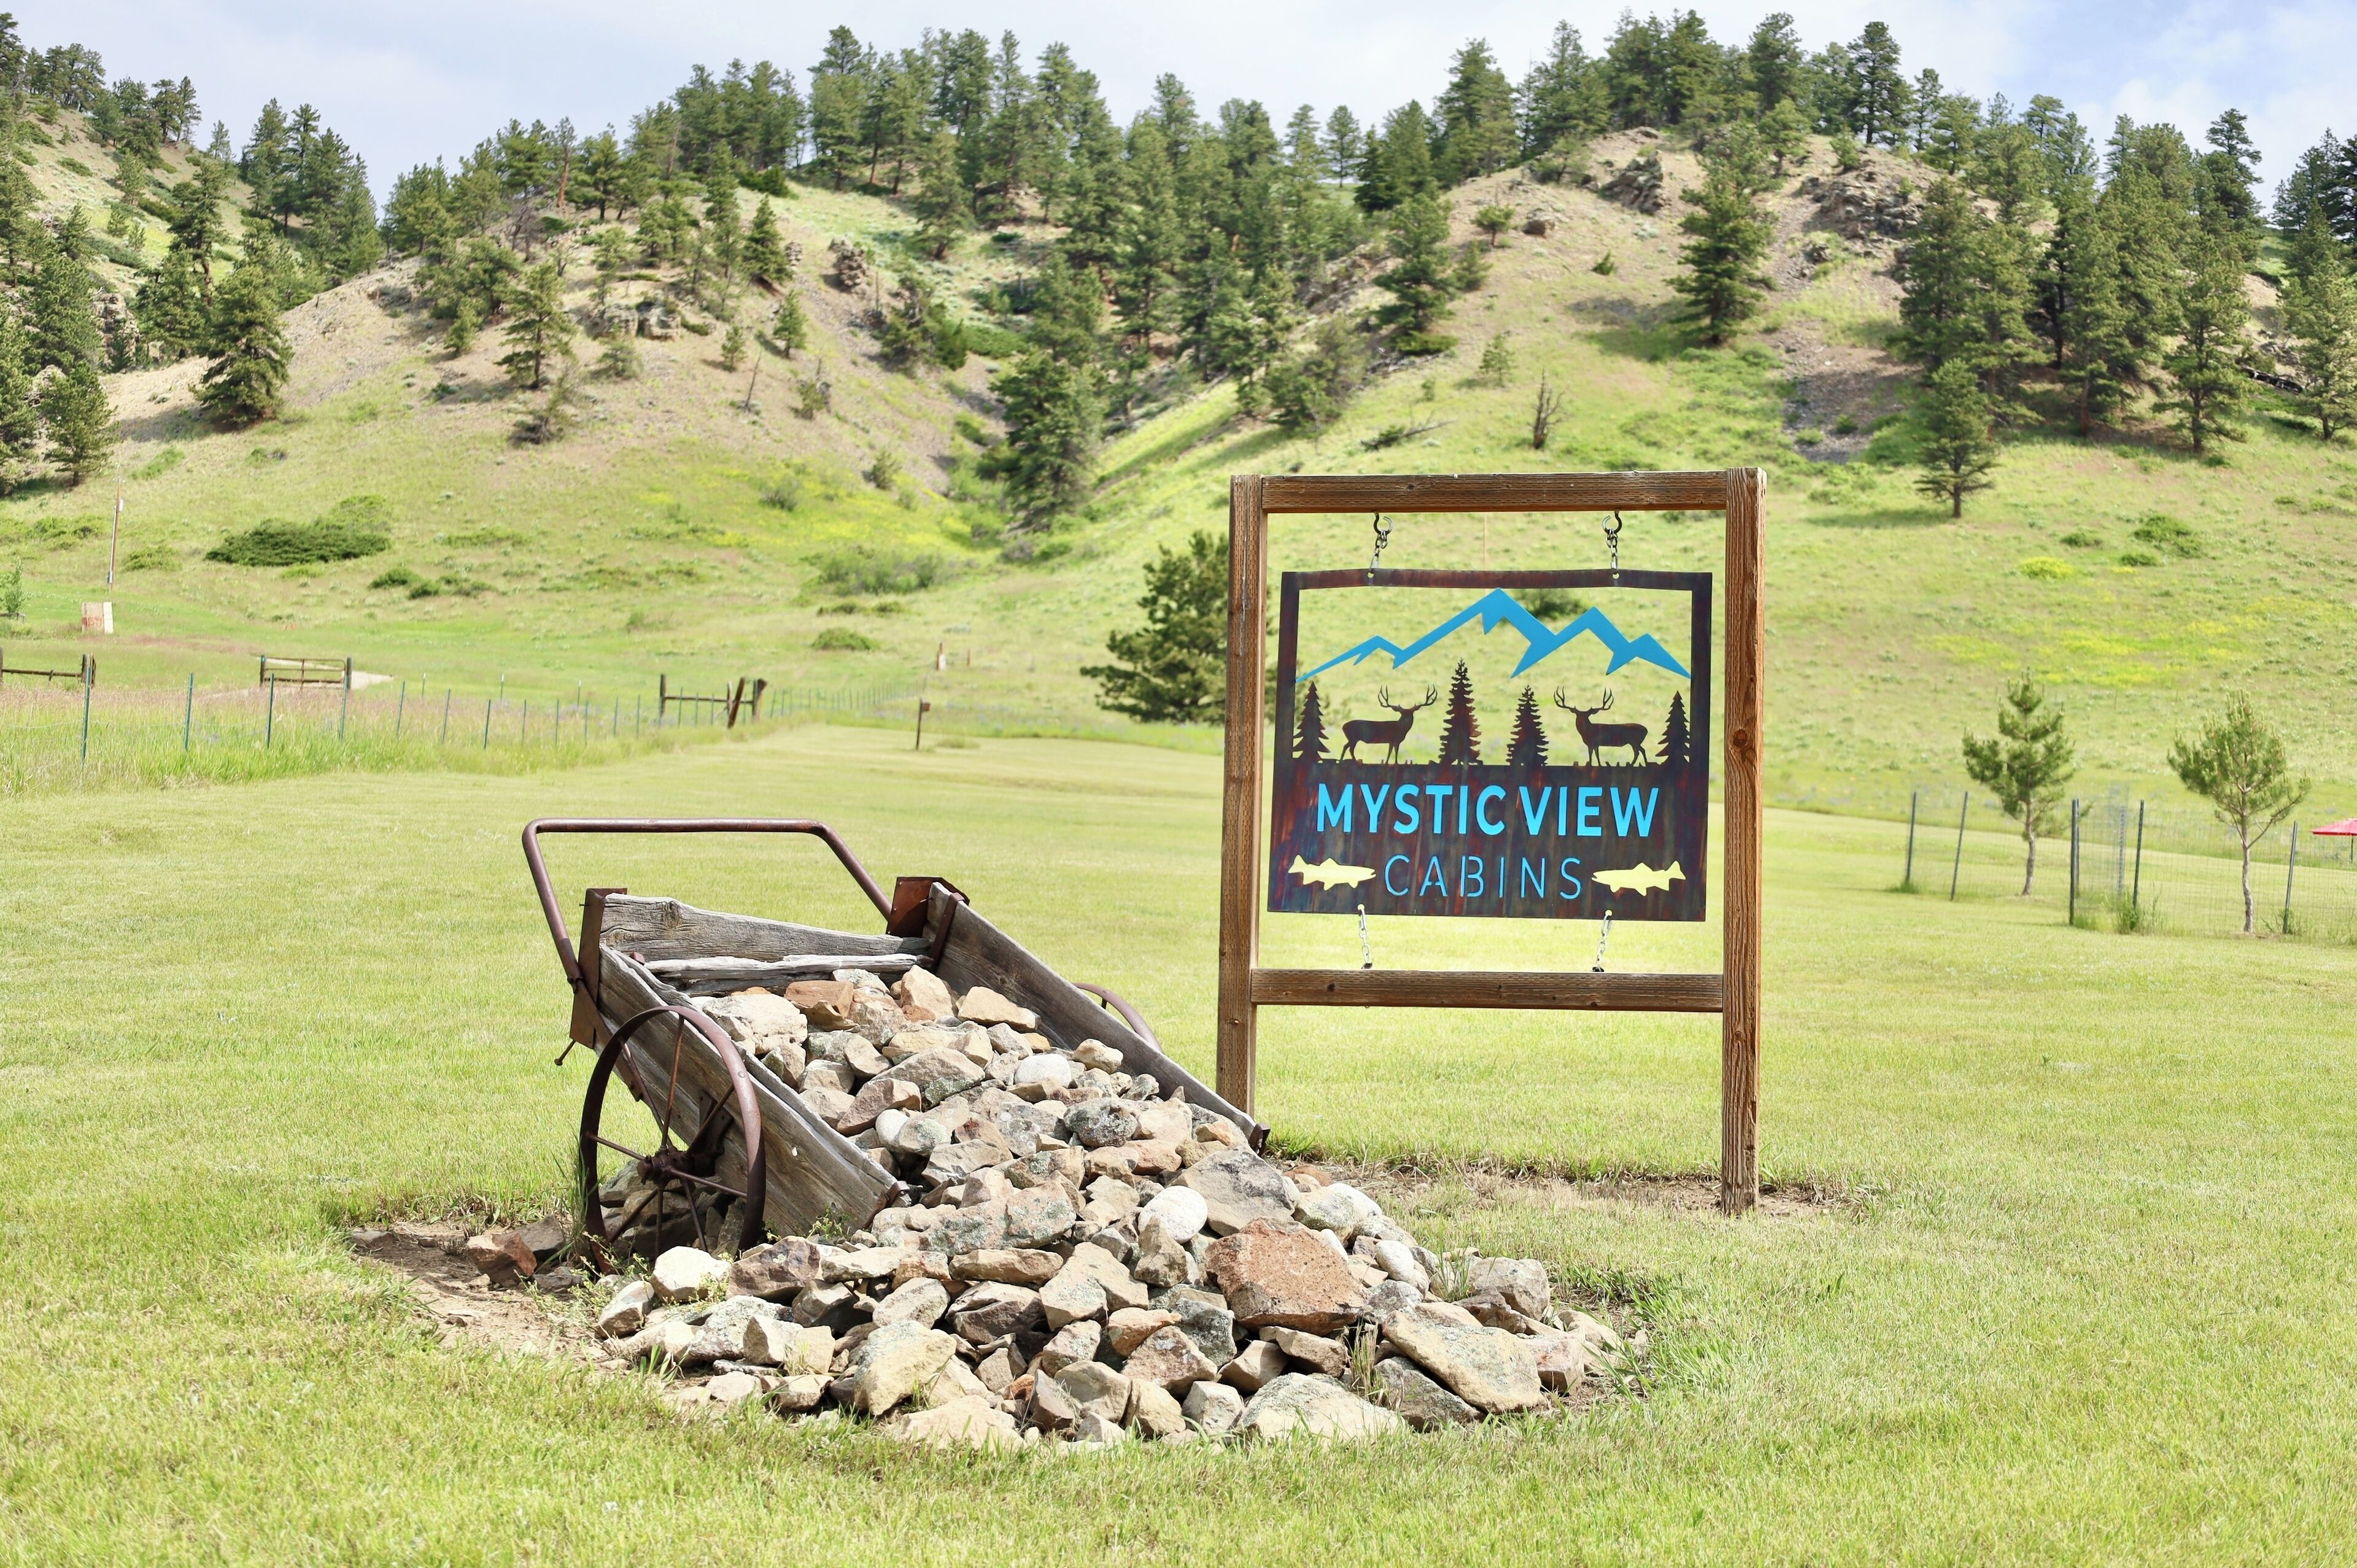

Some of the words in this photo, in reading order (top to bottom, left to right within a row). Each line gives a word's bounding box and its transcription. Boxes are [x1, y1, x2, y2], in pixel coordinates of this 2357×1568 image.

[1316, 782, 1506, 836] MYSTIC
[1518, 786, 1659, 838] VIEW
[1384, 854, 1582, 900] CABINS
